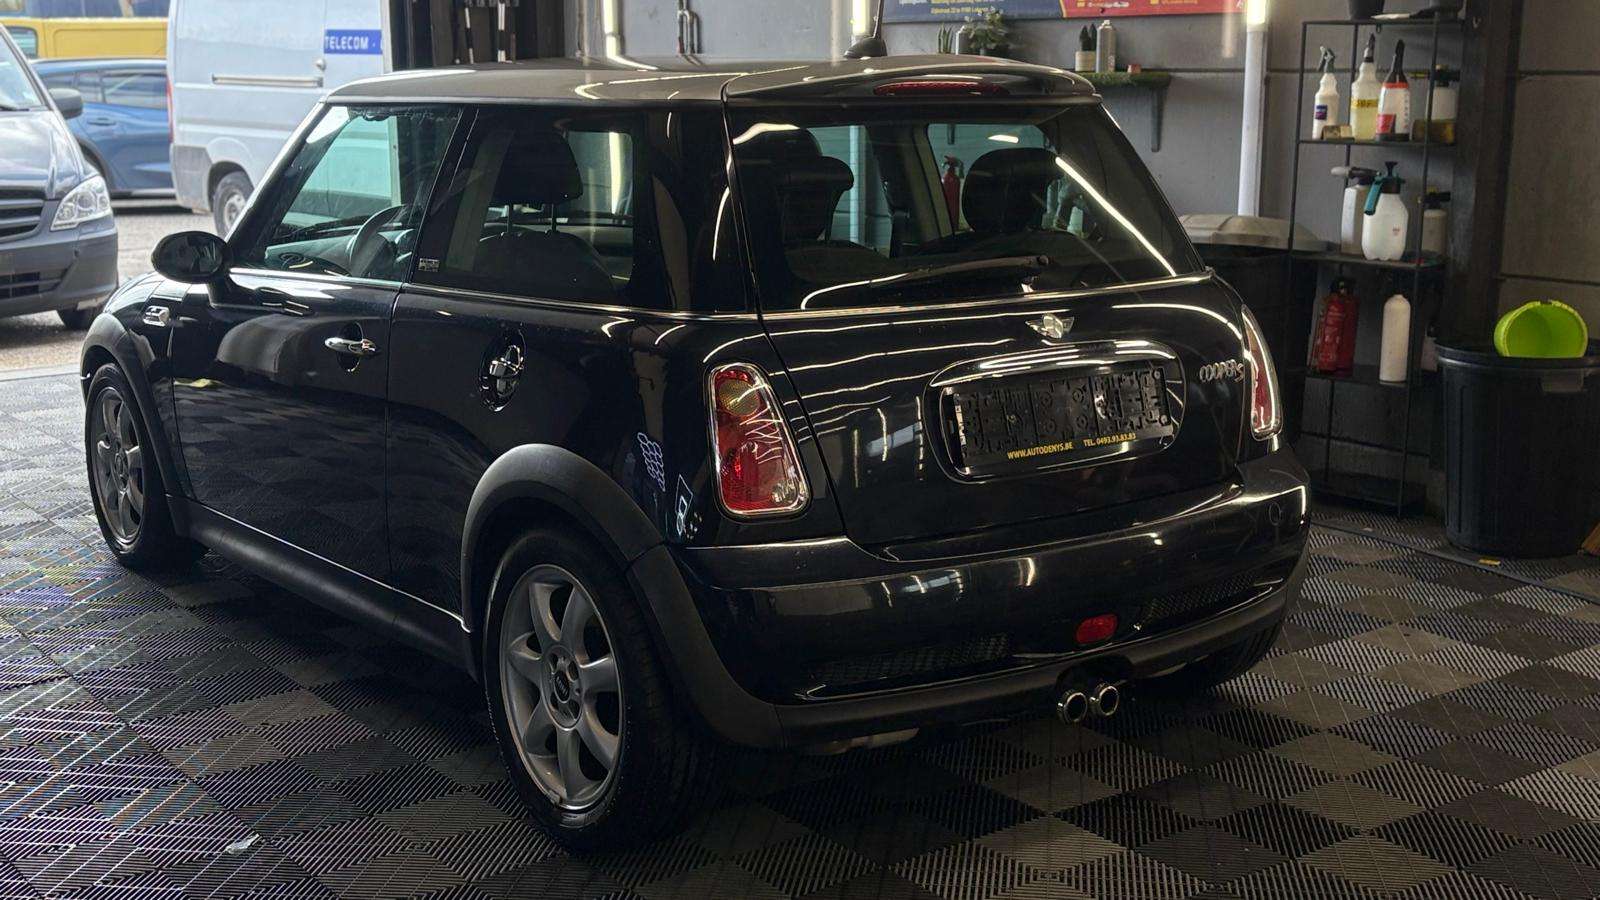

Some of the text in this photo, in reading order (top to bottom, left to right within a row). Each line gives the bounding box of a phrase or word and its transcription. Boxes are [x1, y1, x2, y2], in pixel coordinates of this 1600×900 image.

[325, 36, 368, 50] TELECOM
[1007, 442, 1073, 459] WWW.AUTODENYS.BE
[1083, 439, 1096, 447] TEL.
